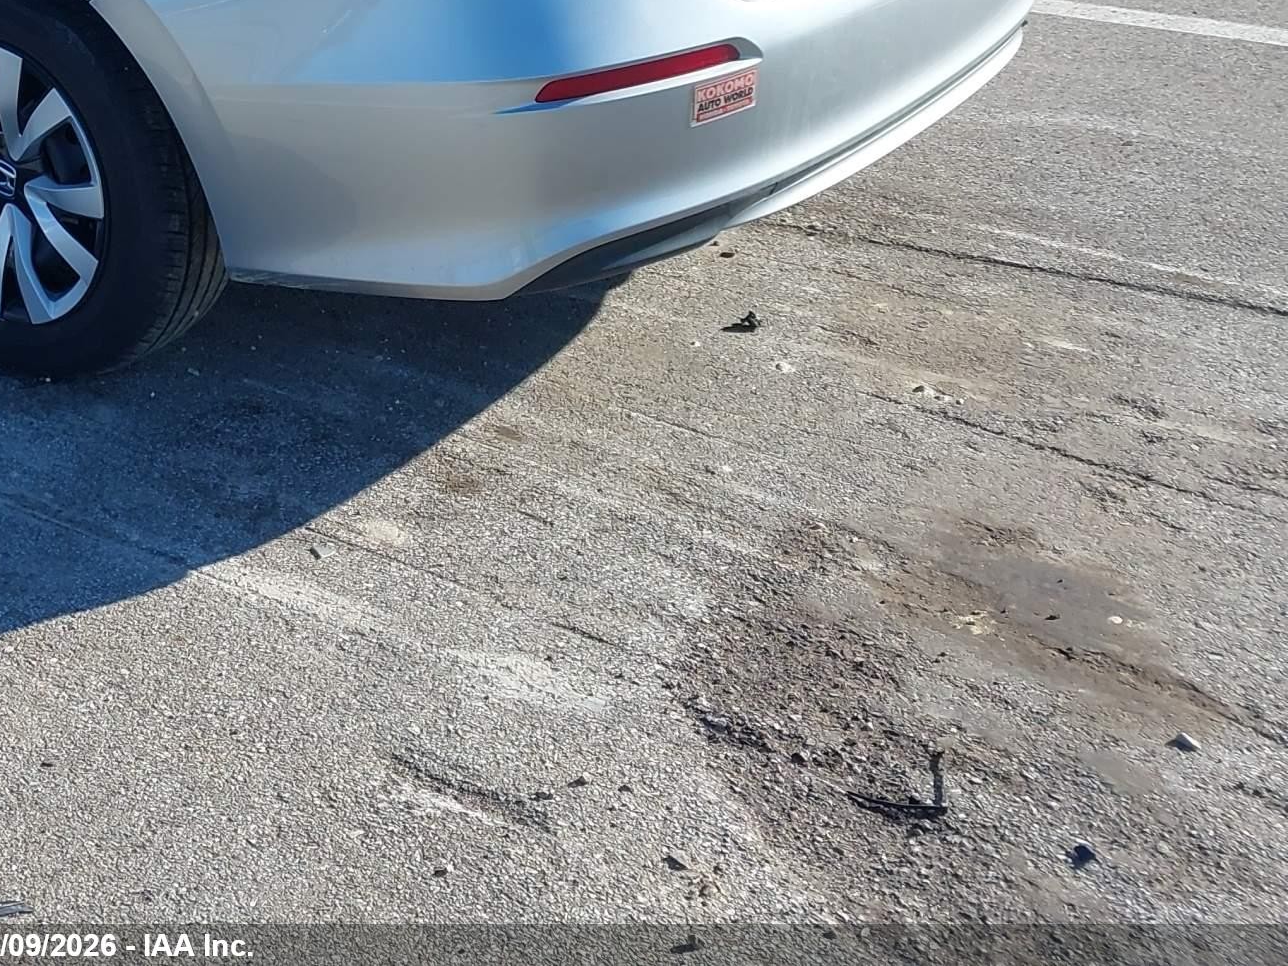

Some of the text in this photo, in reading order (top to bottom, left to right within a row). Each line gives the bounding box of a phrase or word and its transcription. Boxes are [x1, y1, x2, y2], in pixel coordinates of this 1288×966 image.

[697, 74, 754, 102] KOKOMO
[697, 97, 721, 112] AUTO
[724, 87, 754, 104] WORLD
